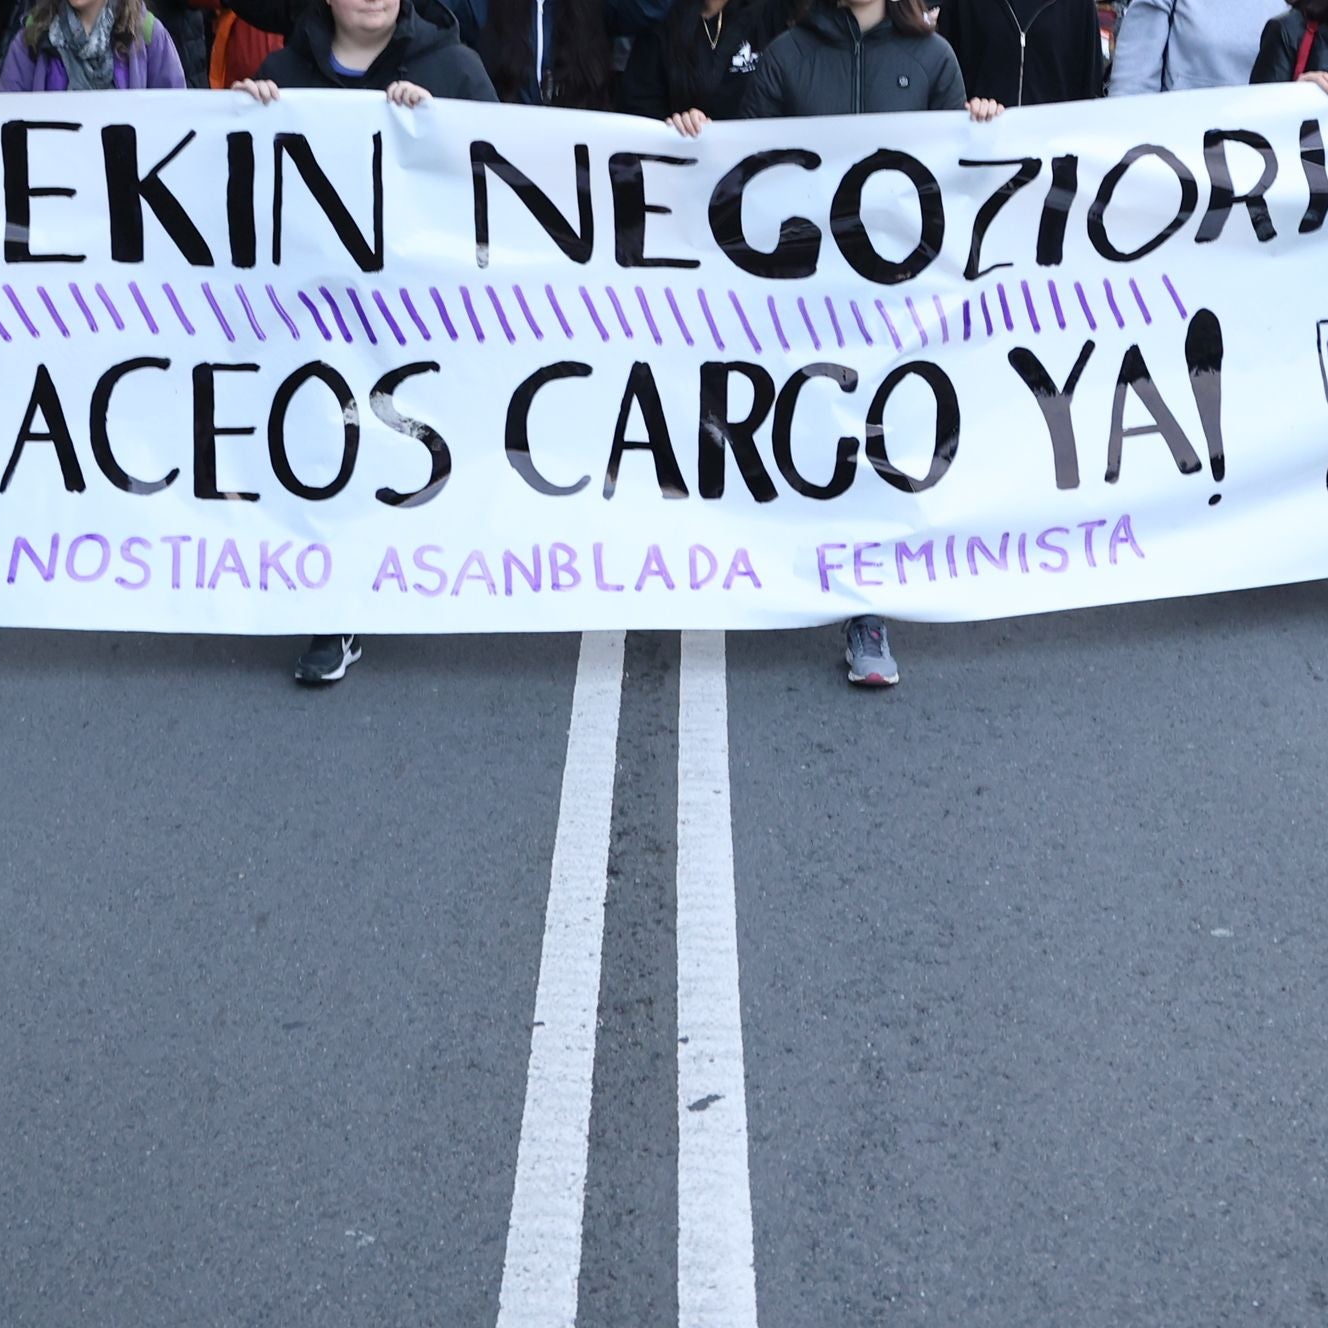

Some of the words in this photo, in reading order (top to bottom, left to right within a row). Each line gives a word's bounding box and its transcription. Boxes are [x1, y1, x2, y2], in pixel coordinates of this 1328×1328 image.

[504, 359, 961, 504] CARGO
[1007, 308, 1227, 507] YA!
[372, 541, 763, 596] ASANBLADA
[816, 514, 1145, 592] FEMINISTA
